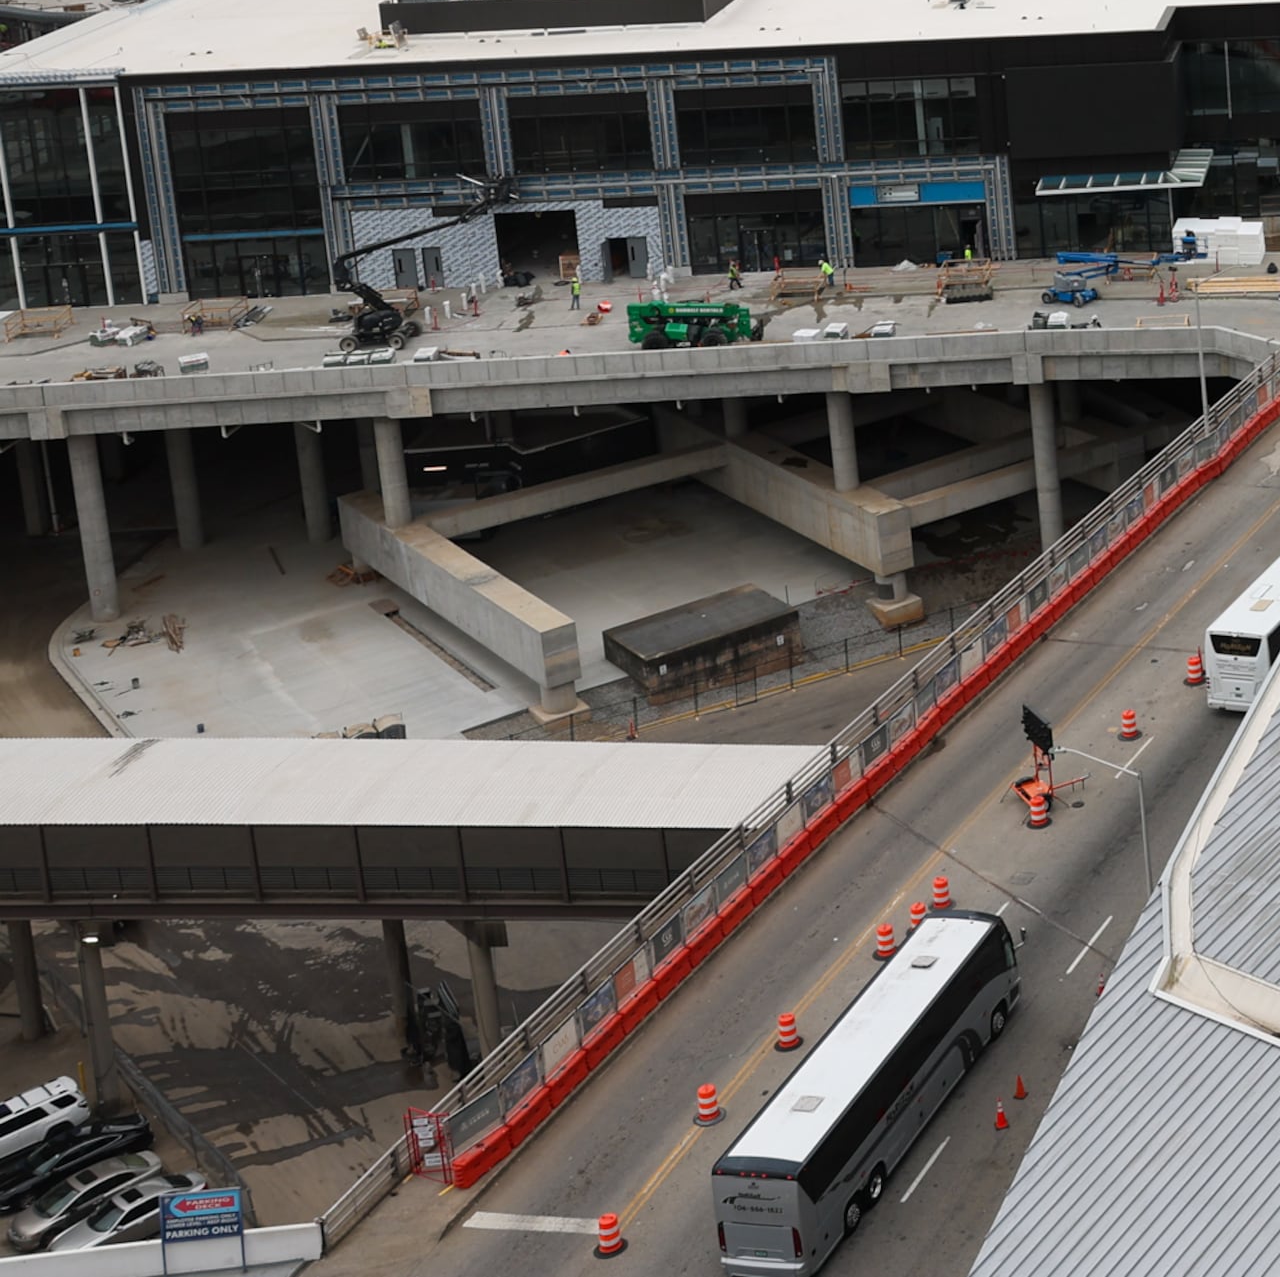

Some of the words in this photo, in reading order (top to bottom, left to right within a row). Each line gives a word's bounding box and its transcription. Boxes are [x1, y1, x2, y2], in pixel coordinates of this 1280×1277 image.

[186, 1197, 230, 1206] PARKING
[165, 1228, 210, 1240] PARKING
[211, 1224, 239, 1235] ONLY
